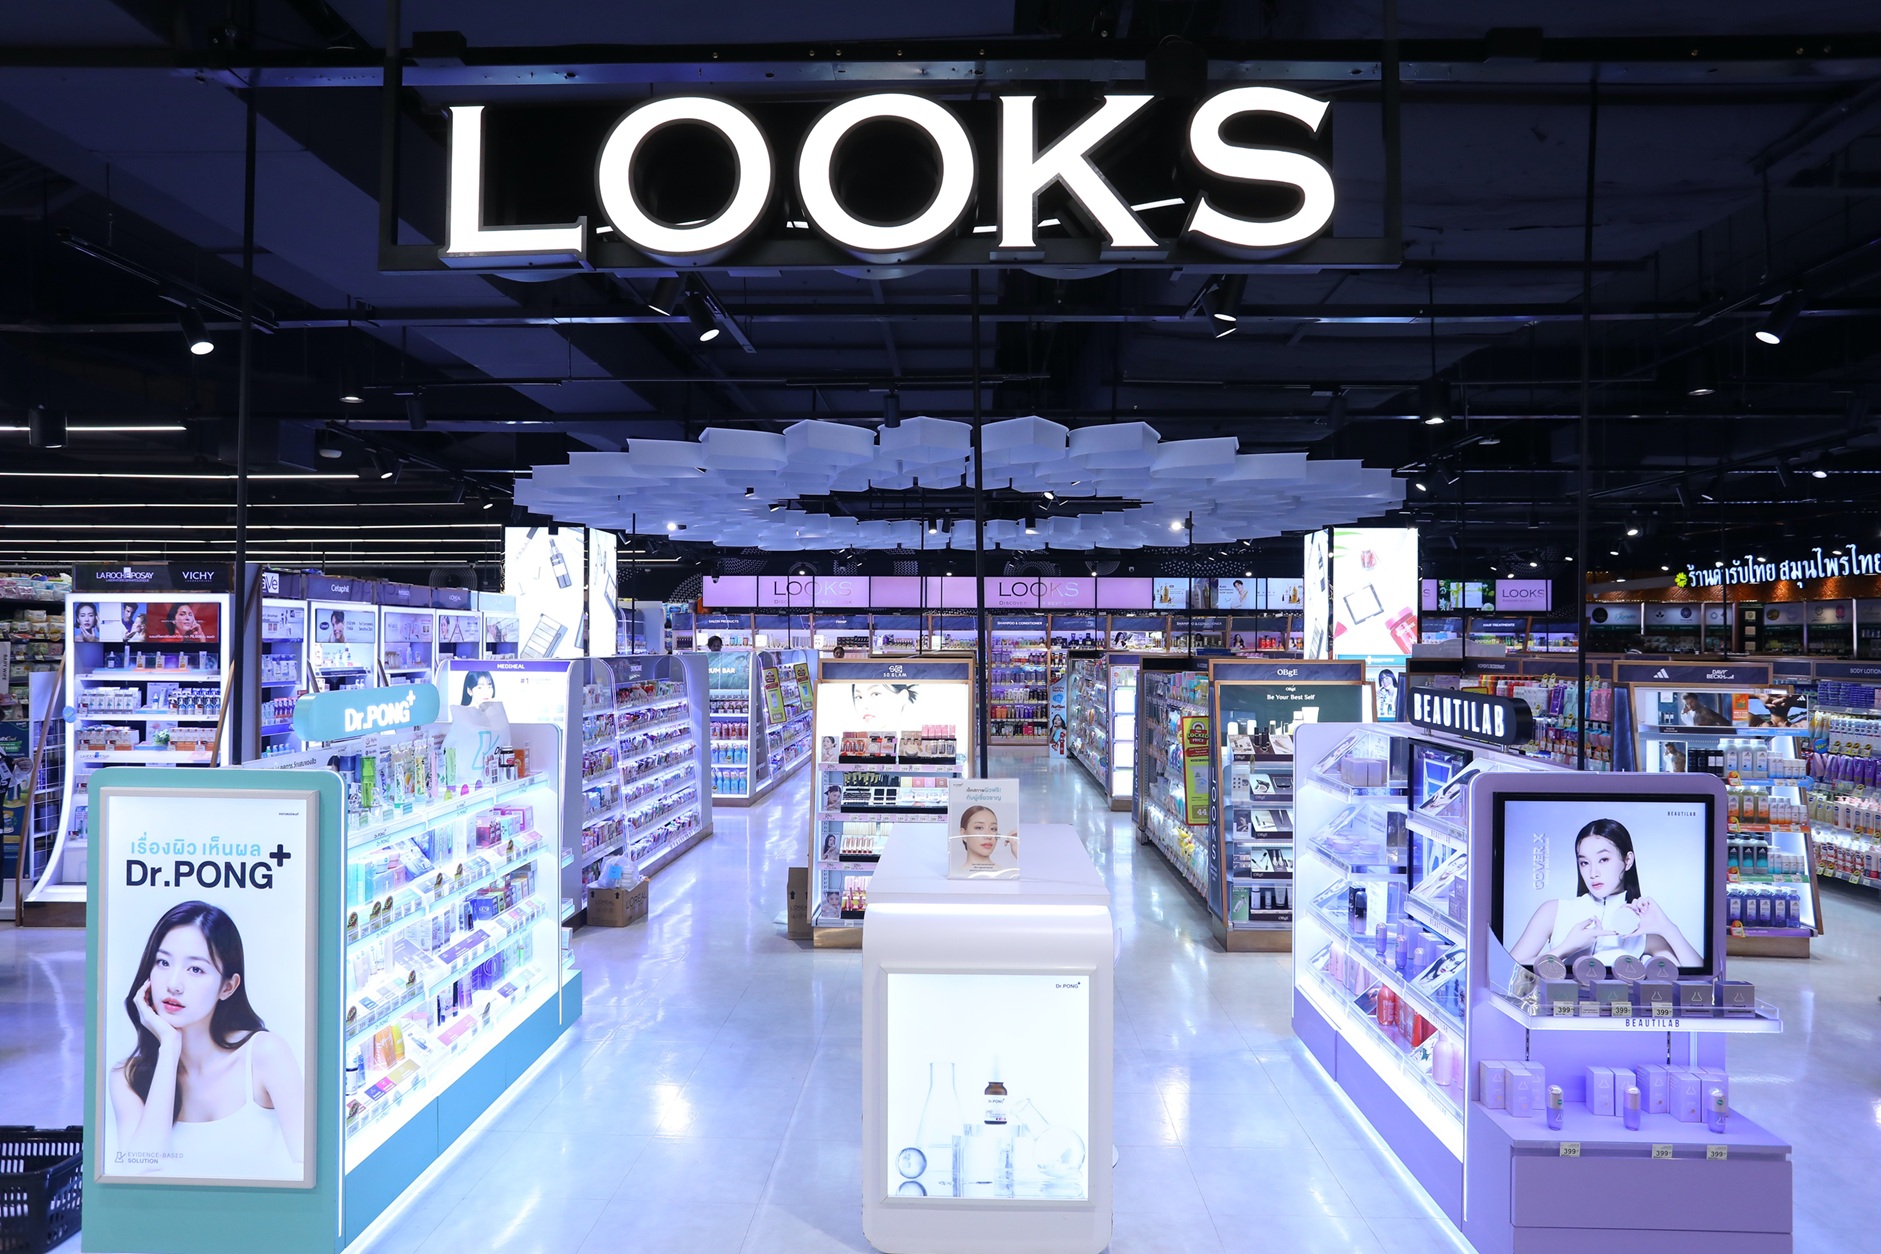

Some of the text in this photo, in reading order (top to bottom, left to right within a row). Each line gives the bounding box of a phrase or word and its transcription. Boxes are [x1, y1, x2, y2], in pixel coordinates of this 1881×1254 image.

[446, 86, 1336, 255] LOOKS
[182, 571, 215, 580] VICHY
[330, 584, 350, 593] Cetaphil
[773, 581, 853, 596] LOOKS
[999, 582, 1079, 597] LOOKS
[1502, 589, 1545, 598] LOOKS
[1277, 669, 1298, 677] OBgE
[1414, 693, 1504, 737] BEAUTILAB
[130, 831, 261, 857] เรื่องผิว เห็นผล
[1533, 833, 1545, 890] COVER X
[1625, 1018, 1680, 1028] BEAUTILAB
[127, 1151, 184, 1159] EVIDENCE-BASED
